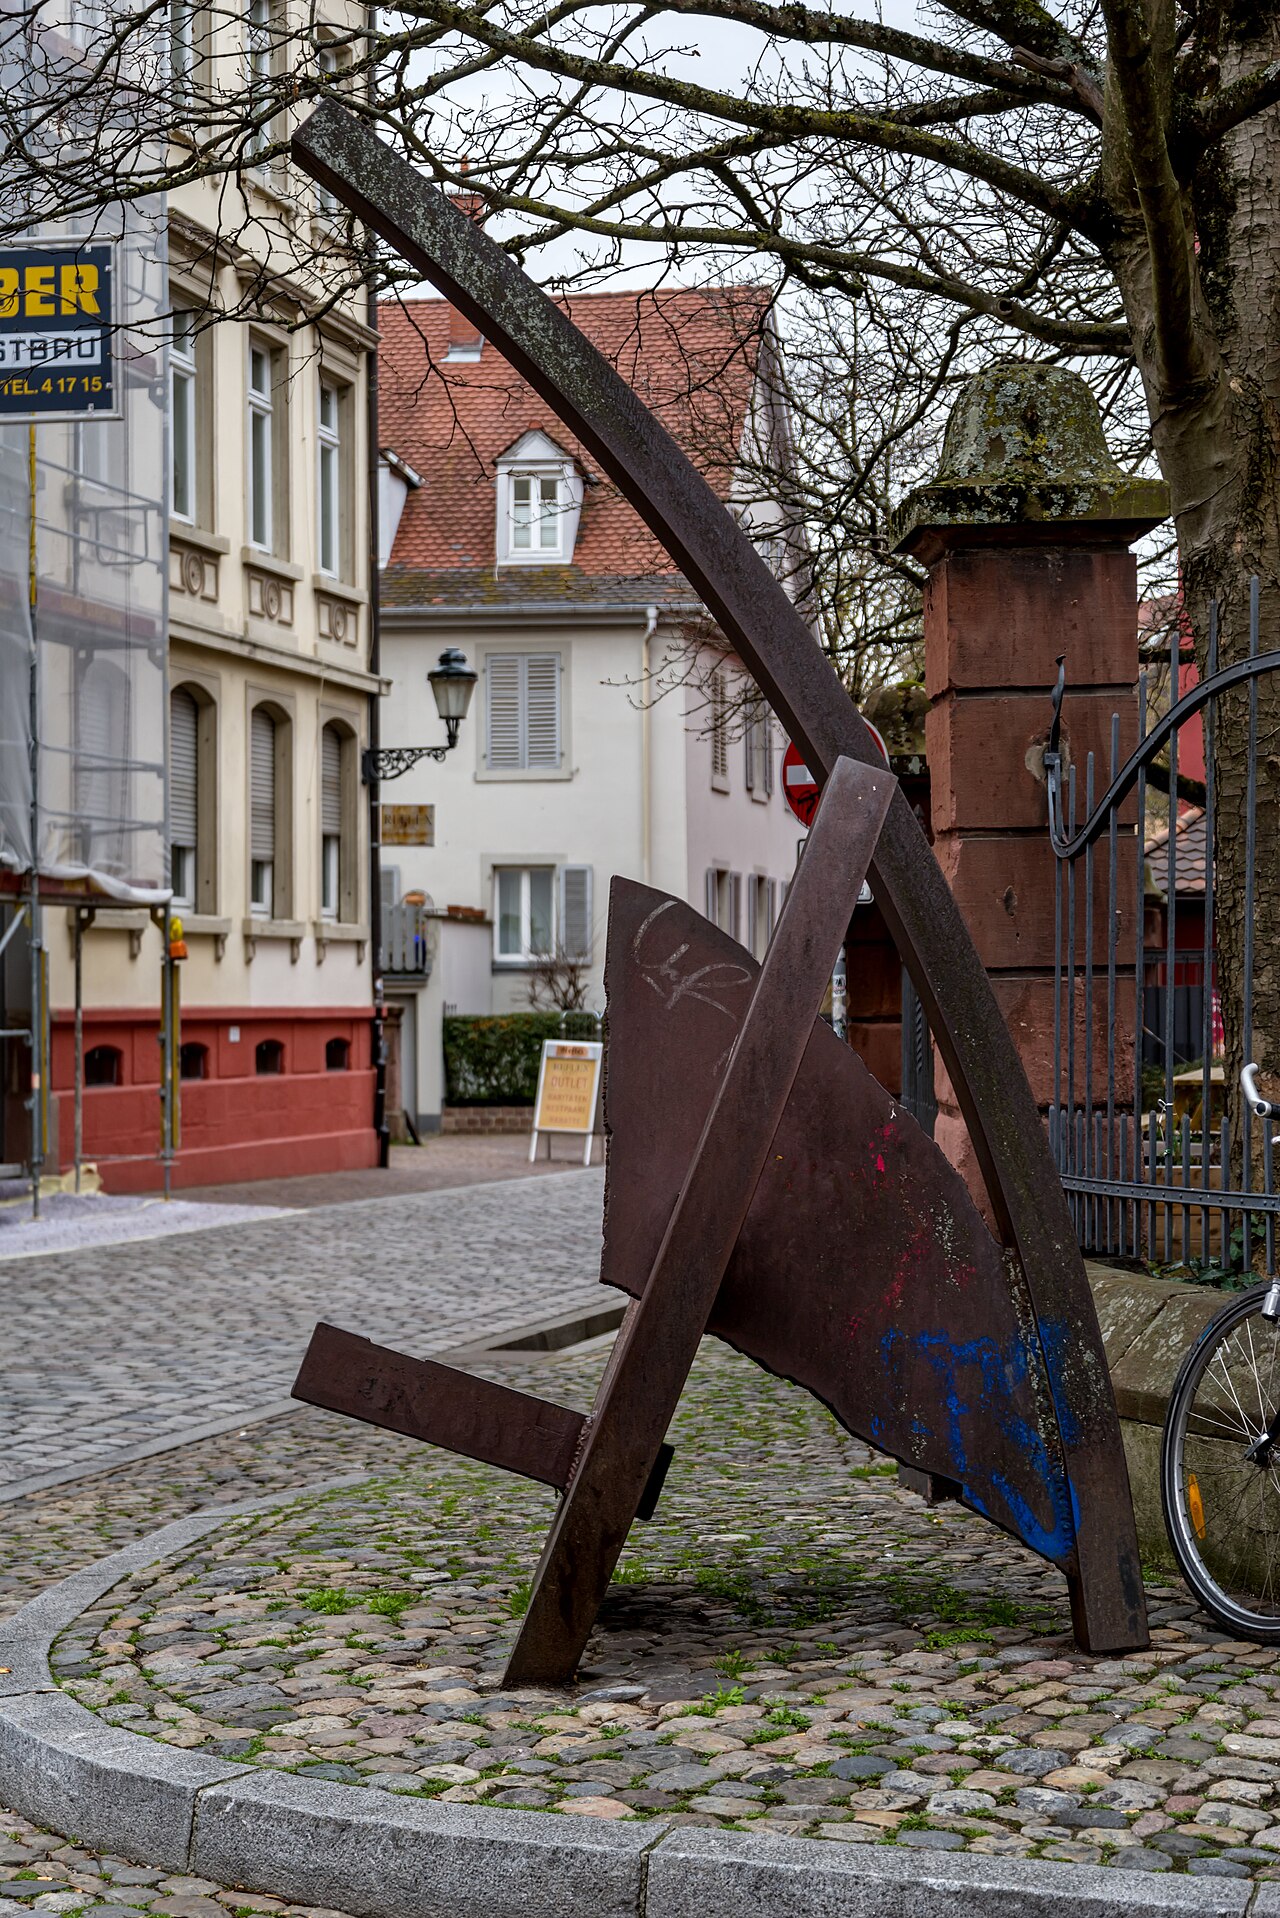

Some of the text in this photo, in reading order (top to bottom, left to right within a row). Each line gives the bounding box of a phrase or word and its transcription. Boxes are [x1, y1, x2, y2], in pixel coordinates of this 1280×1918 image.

[0, 376, 102, 395] TEL. 4 17 15
[551, 1077, 588, 1089] OUTLET
